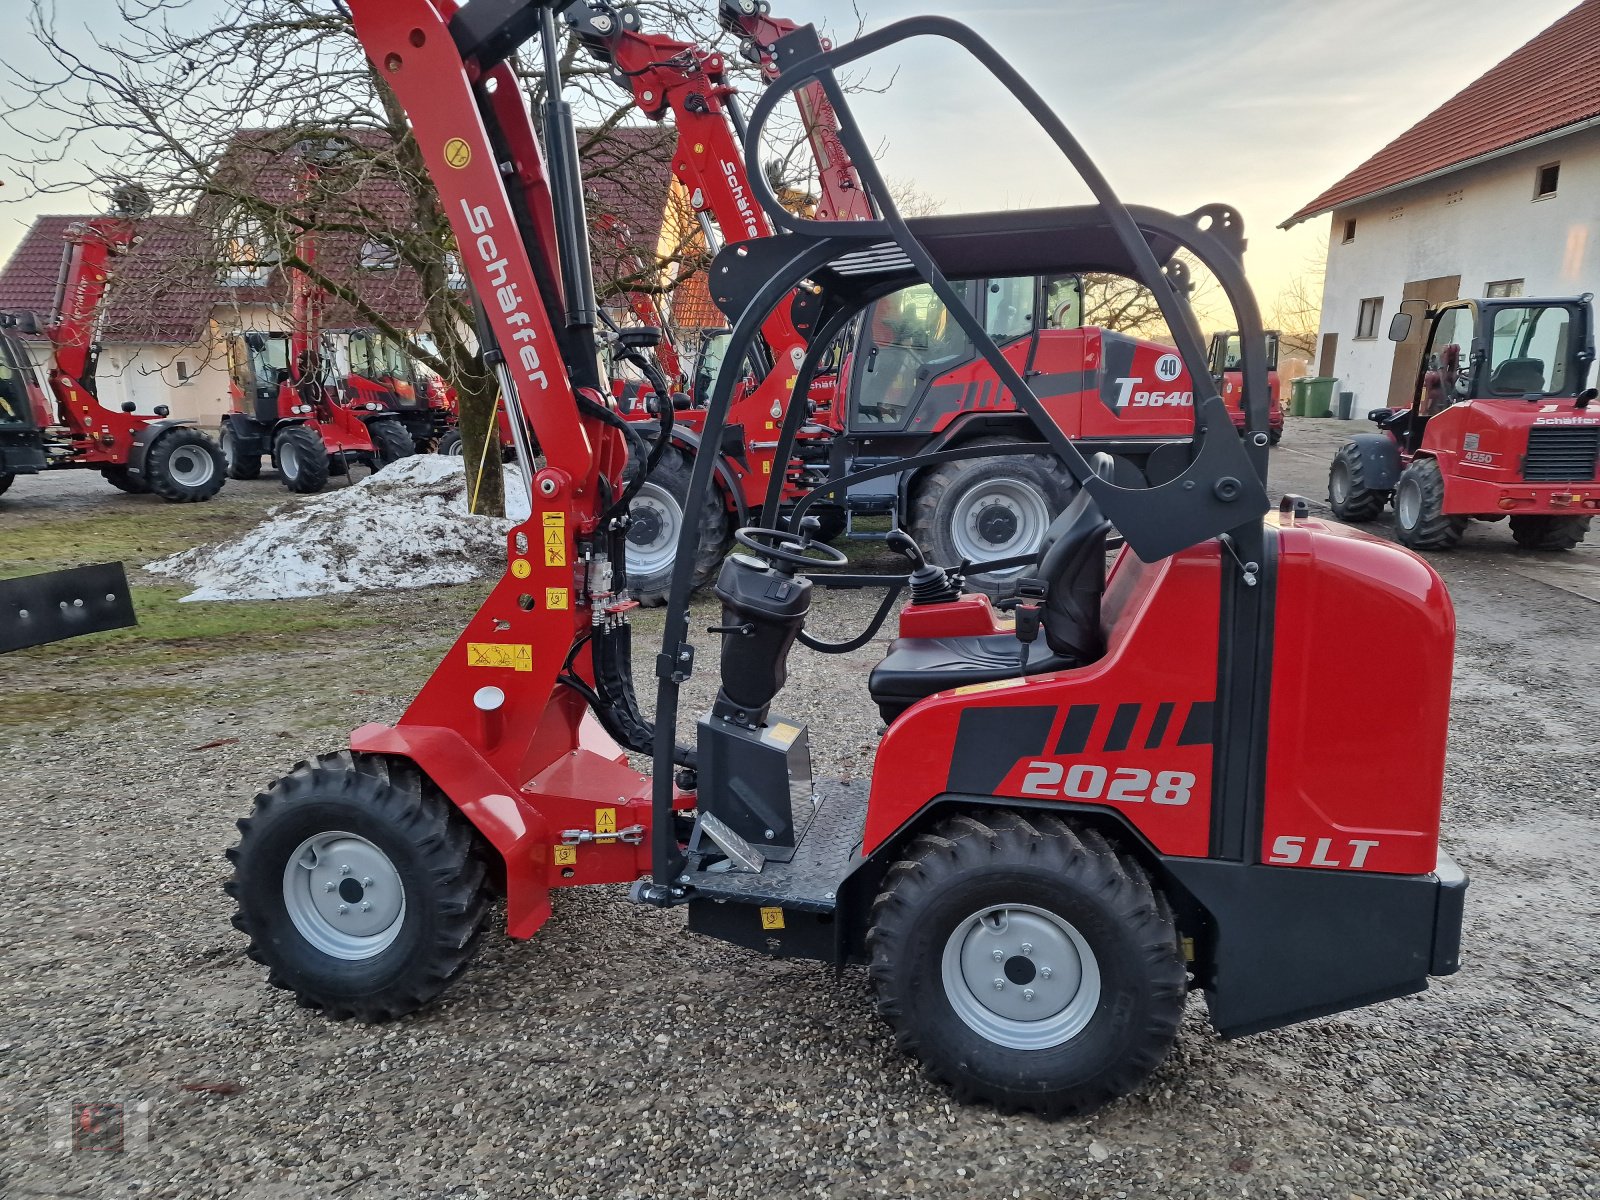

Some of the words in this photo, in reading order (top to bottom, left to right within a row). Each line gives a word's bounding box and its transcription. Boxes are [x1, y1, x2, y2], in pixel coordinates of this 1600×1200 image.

[719, 159, 759, 238] Schäffe
[459, 198, 549, 390] Schäffer
[1160, 359, 1177, 376] 40
[810, 380, 837, 389] chäff
[1114, 377, 1194, 407] T9640
[1533, 416, 1600, 425] Schäffer
[1020, 760, 1197, 806] 2028
[1268, 835, 1380, 868] SLT
